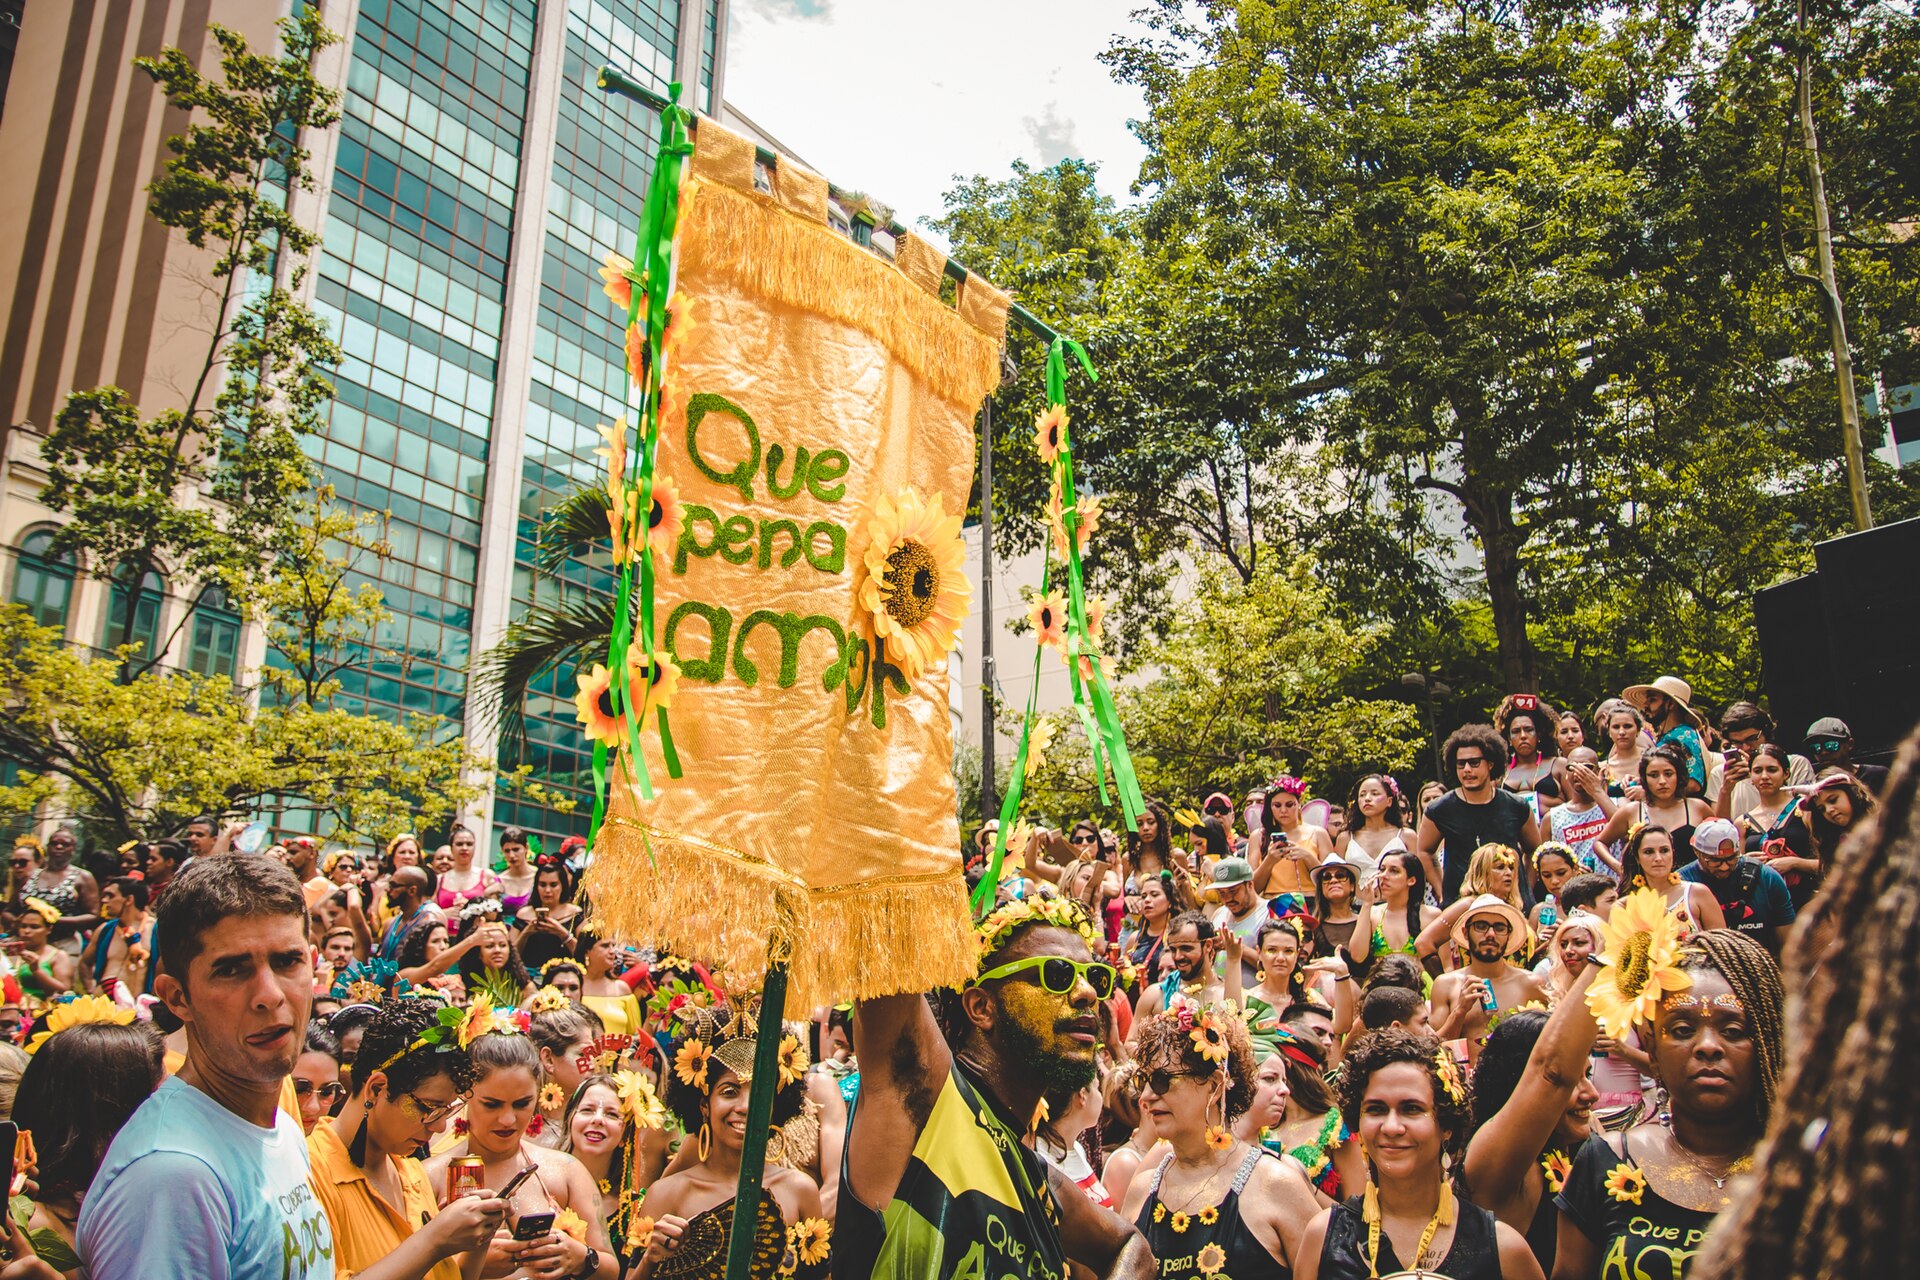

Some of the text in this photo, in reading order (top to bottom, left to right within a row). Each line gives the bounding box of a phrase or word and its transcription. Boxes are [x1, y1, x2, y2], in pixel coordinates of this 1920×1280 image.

[686, 393, 850, 501] Que
[673, 503, 847, 575] pena
[664, 601, 912, 730] amor
[1565, 822, 1608, 841] Suprem
[330, 957, 399, 1000] BRILHO
[575, 1033, 633, 1074] BRILHO
[986, 1213, 1026, 1264] Que
[1628, 1216, 1680, 1240] Que
[1162, 1255, 1193, 1277] pena
